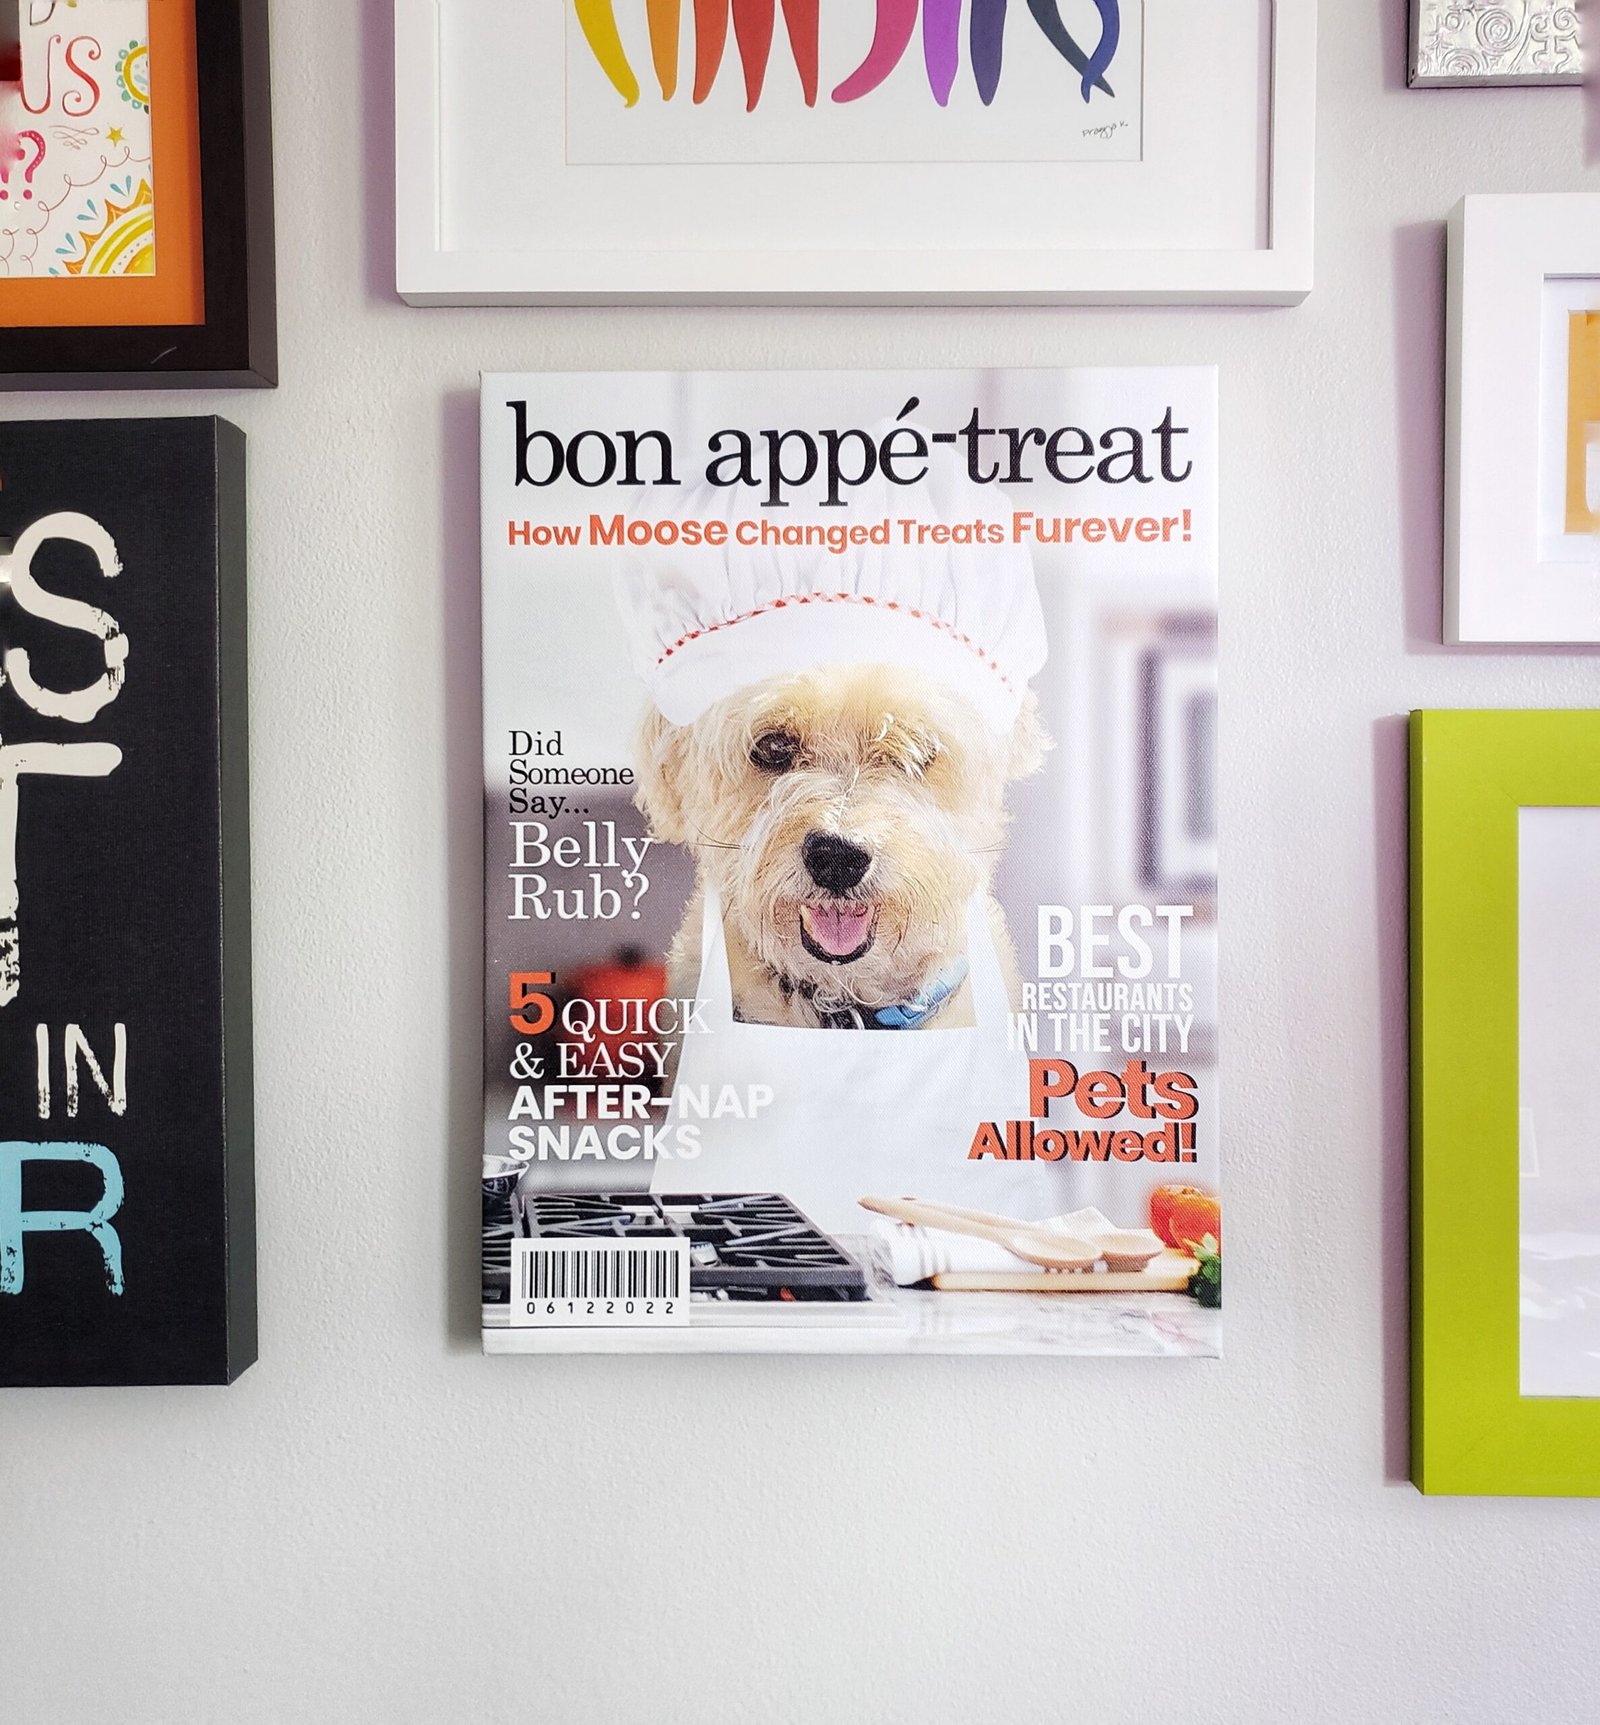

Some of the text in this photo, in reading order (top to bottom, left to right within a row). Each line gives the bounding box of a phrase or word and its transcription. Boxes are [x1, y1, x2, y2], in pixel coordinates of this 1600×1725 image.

[506, 396, 1193, 507] bon appé-treat
[508, 508, 1192, 555] How Moose Changed Treats Furever!
[508, 731, 564, 756] Did
[509, 759, 634, 785] Someone
[509, 788, 589, 819] Say...
[508, 820, 653, 878] Belly
[508, 873, 650, 920] Rub?
[1037, 905, 1194, 979] BEST
[509, 971, 714, 1042] 5 QUICK
[1022, 982, 1194, 1012] RESTAURANTS
[1007, 1013, 1194, 1054] IN THE CITY
[36, 1023, 127, 1120] IN
[509, 1042, 677, 1079] & EASY
[508, 1084, 774, 1121] AFTER-NAP
[1029, 1058, 1200, 1120] Pets
[508, 1125, 701, 1160] SNACKS
[967, 1121, 1198, 1163] Allowed!
